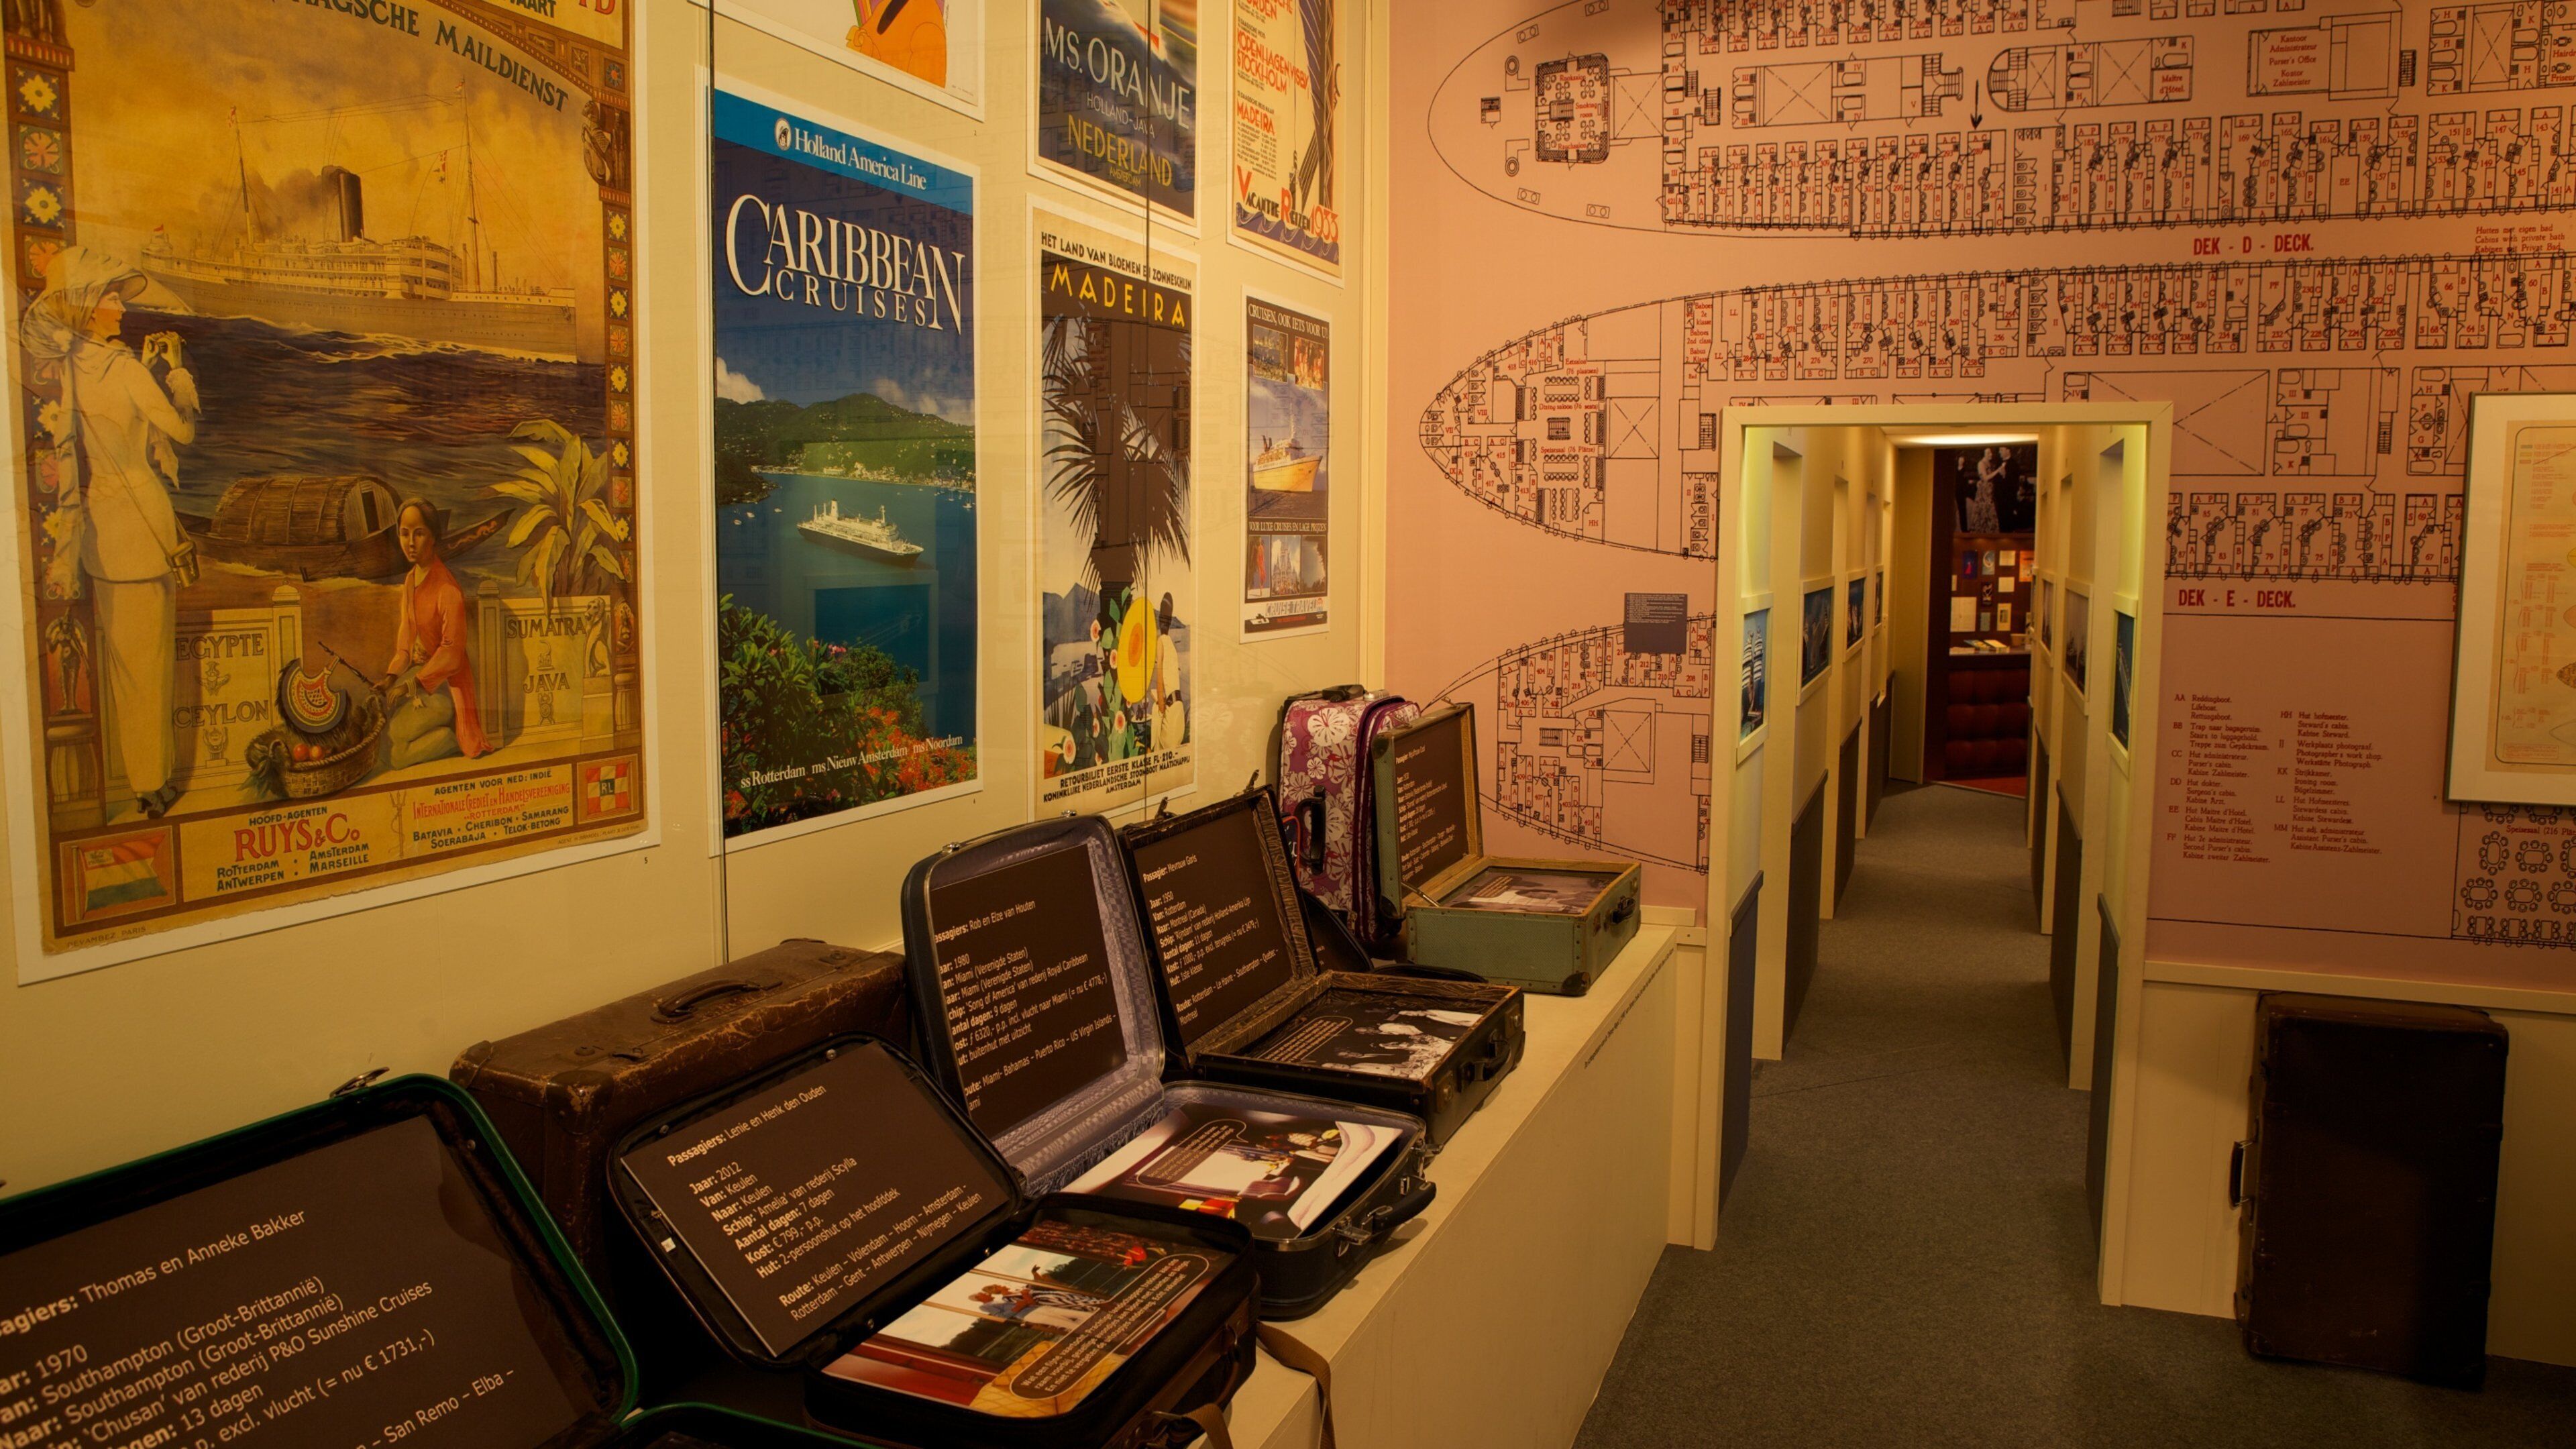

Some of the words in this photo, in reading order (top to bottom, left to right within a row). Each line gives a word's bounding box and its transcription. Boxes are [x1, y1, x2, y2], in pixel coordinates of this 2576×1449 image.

[2270, 43, 2317, 53] Administrateur
[2281, 34, 2306, 43] Kantoor
[435, 19, 568, 113] MAILDIENST
[1237, 48, 1287, 95] STOCKHOLM
[2281, 68, 2304, 77] Kontor
[2298, 56, 2316, 64] Office
[1088, 36, 1190, 129] ORANJE
[2273, 77, 2311, 87] Zahlmeister
[1237, 101, 1275, 136] MADEIRA
[795, 127, 847, 165] Holland
[848, 146, 899, 182] America
[901, 163, 926, 191] Line
[1068, 114, 1172, 187] NEDERLAND
[1110, 166, 1141, 188] AMSTERDAM
[2514, 168, 2526, 176] 145
[1309, 204, 1338, 243] 1933
[2521, 235, 2545, 243] private
[1041, 231, 1057, 250] HET
[1061, 238, 1085, 258] LAND
[1087, 247, 1106, 265] VAN
[1109, 254, 1140, 275] BLOEMEN
[1152, 266, 1191, 290] ZONNESCHIJN
[2194, 237, 2220, 256] DEK
[2243, 236, 2251, 254] D
[2274, 233, 2314, 252] DECK.
[726, 195, 965, 335] CARIBBEAN
[775, 270, 926, 326] CRUISES
[1051, 263, 1185, 327] MADEIRA
[1248, 303, 1277, 326] CRUISEN,
[1278, 313, 1291, 328] OOK
[1292, 317, 1305, 333] IETS
[1306, 321, 1320, 337] VOOR
[1265, 602, 1291, 616] CRUISE
[1292, 600, 1316, 614] TRAVEL
[2179, 589, 2205, 606] DEK
[2226, 590, 2235, 606] E
[2257, 590, 2296, 608] DECK.
[507, 617, 587, 638] SUMATRA
[176, 633, 264, 661] EGYPTE
[523, 672, 570, 694] JAVA
[173, 700, 268, 729] CEYLON
[741, 776, 751, 788] ss
[751, 765, 805, 786] Rotterdam
[812, 762, 826, 774] ms
[827, 755, 857, 771] Nieuw
[858, 745, 908, 764] Amsterdam
[913, 742, 926, 755] ms
[926, 734, 962, 751] Noordam
[1044, 786, 1081, 802] KONINKLIJKE
[1083, 774, 1127, 792] NEDERLANDSCHE
[1130, 766, 1158, 780] STOOMBOOT
[1160, 755, 1190, 771] MAATSCHAPPIJ
[1060, 769, 1104, 789] RETOURBILJET
[1107, 763, 1129, 775] EERSTE
[1131, 757, 1151, 769] KLASSE
[435, 782, 476, 796] AGENTEN
[480, 777, 503, 789] VOOR
[507, 774, 527, 785] NED:
[530, 769, 551, 780] INDIË
[1106, 779, 1140, 794] AMSTERDAM
[249, 806, 327, 826] HOOFD-AGENTEN
[413, 799, 465, 820] INTERNATIONALE
[498, 782, 570, 805] HANDELSVEREENIGING
[413, 826, 452, 841] BATAVIA
[466, 816, 513, 832] CHERIBON
[522, 806, 569, 822] SAMARANG
[431, 832, 486, 849] SOERABAJA
[217, 870, 284, 892] ANTWERPEN
[309, 853, 369, 873] MARSEILLE
[969, 918, 981, 931] Rob
[982, 916, 990, 926] en
[1004, 908, 1014, 919] van
[1016, 900, 1036, 915] Houten
[954, 953, 970, 969] 1980
[666, 1134, 727, 1167] Passagiers:
[724, 1121, 749, 1140] Lenie
[749, 1116, 762, 1128] en
[760, 1105, 784, 1123] Henk
[784, 1097, 801, 1112] den
[798, 1084, 826, 1103] Ouden
[689, 1174, 718, 1195] Jaar:
[716, 1161, 743, 1182] 2012
[700, 1189, 727, 1208] Van:
[726, 1174, 758, 1195] Keulen
[79, 1268, 157, 1304] Thomas
[160, 1256, 184, 1275] en
[186, 1233, 250, 1265] Anneke
[250, 1210, 306, 1241] Bakker
[779, 1283, 814, 1308] Route:
[812, 1263, 844, 1286] Keulen
[847, 1234, 888, 1264] Volendam
[894, 1214, 919, 1234] Hoorn
[922, 1186, 963, 1216] Amsterdam
[40, 1339, 173, 1406] Southampton
[176, 1276, 325, 1351] (Groot-Brittannië)
[172, 1381, 208, 1406] van
[211, 1349, 268, 1389] rederij
[270, 1335, 306, 1363] P&O
[307, 1305, 378, 1346] Sunshine
[379, 1281, 433, 1312] Cruises
[35, 1344, 88, 1381] 1970
[64, 1358, 196, 1426] Southampton
[198, 1293, 343, 1369] (Groot-Brittannië)
[218, 1415, 261, 1441] excl.
[263, 1385, 316, 1420] vlucht
[341, 1366, 364, 1385] nu
[364, 1355, 378, 1372] €
[378, 1328, 435, 1367] 1731,-)
[180, 1409, 206, 1434] 13
[209, 1383, 264, 1418] dagen
[384, 1420, 416, 1446] San
[415, 1395, 459, 1427] Remo
[471, 1377, 504, 1399] Elba
